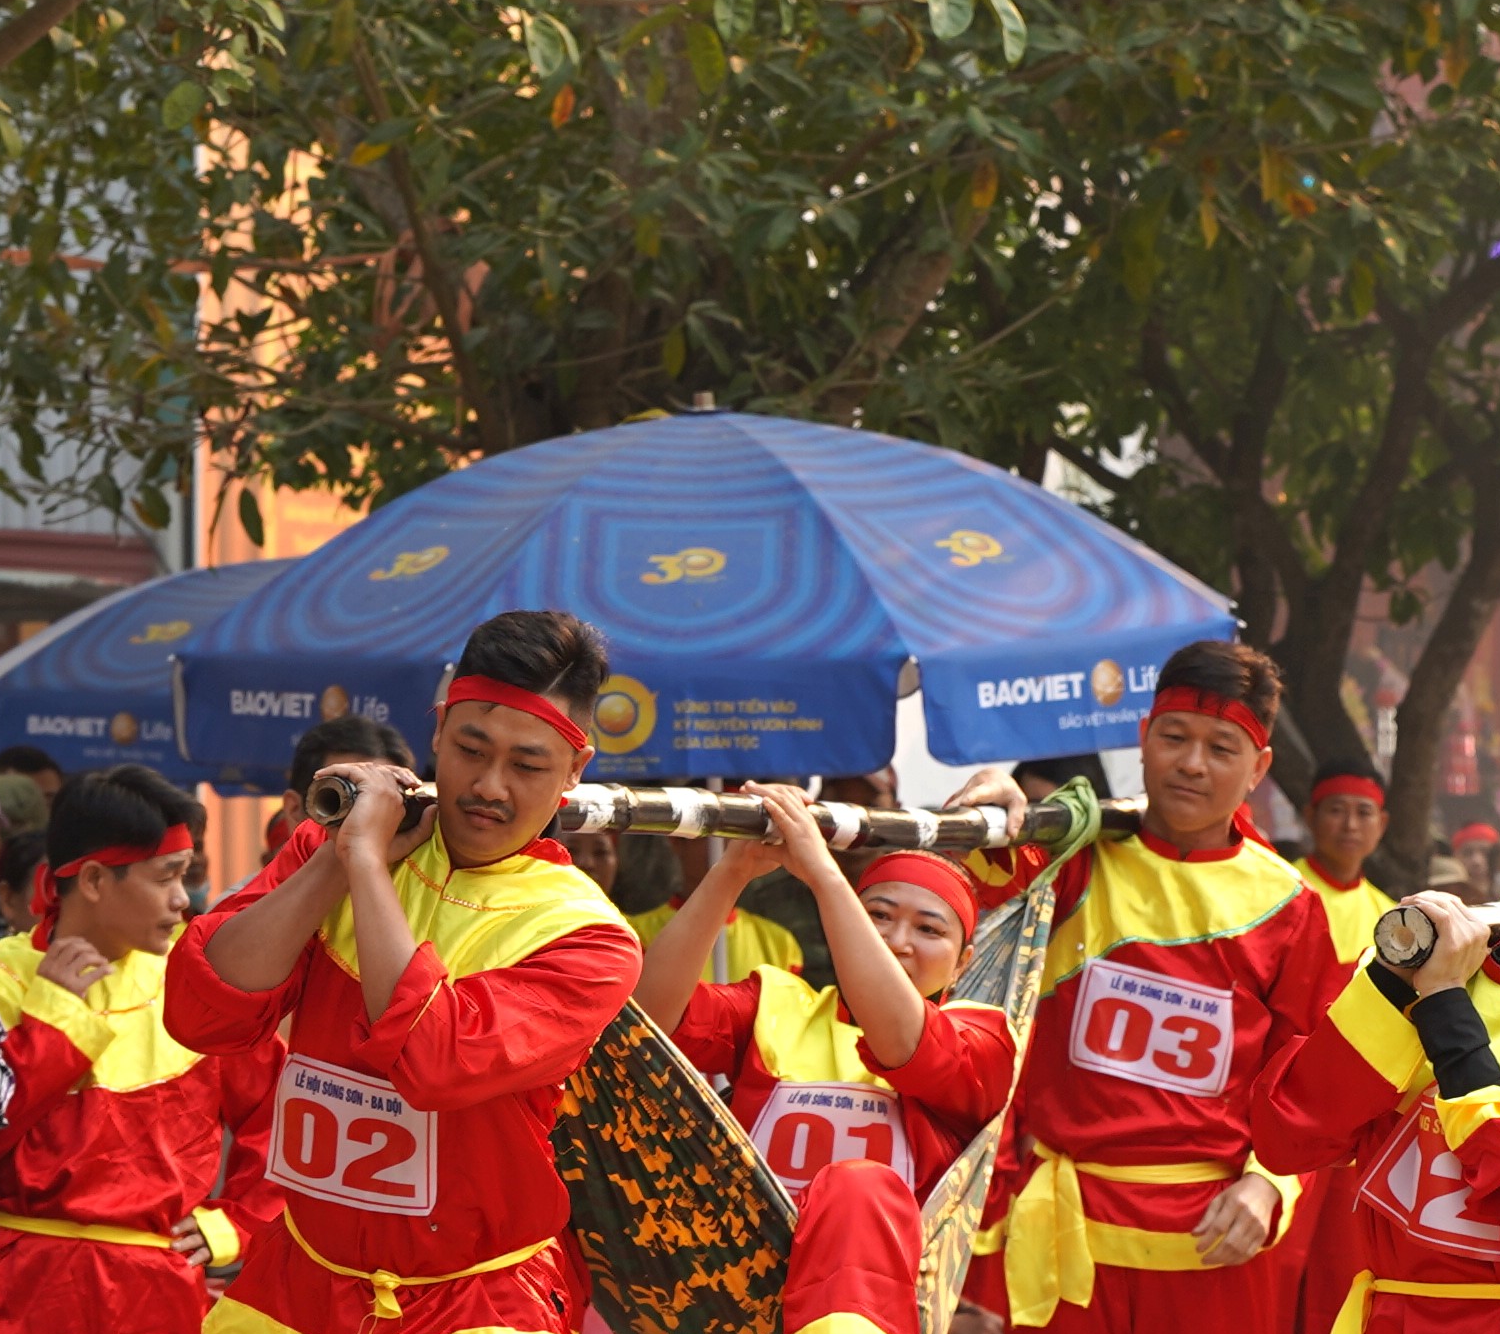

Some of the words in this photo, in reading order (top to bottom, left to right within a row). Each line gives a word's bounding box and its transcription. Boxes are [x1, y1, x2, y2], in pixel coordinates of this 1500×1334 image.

[230, 689, 315, 718] BAOVIET
[977, 671, 1086, 709] BAOVIET
[1084, 996, 1222, 1080] 03
[282, 1097, 418, 1199] 02
[766, 1111, 894, 1179] 01
